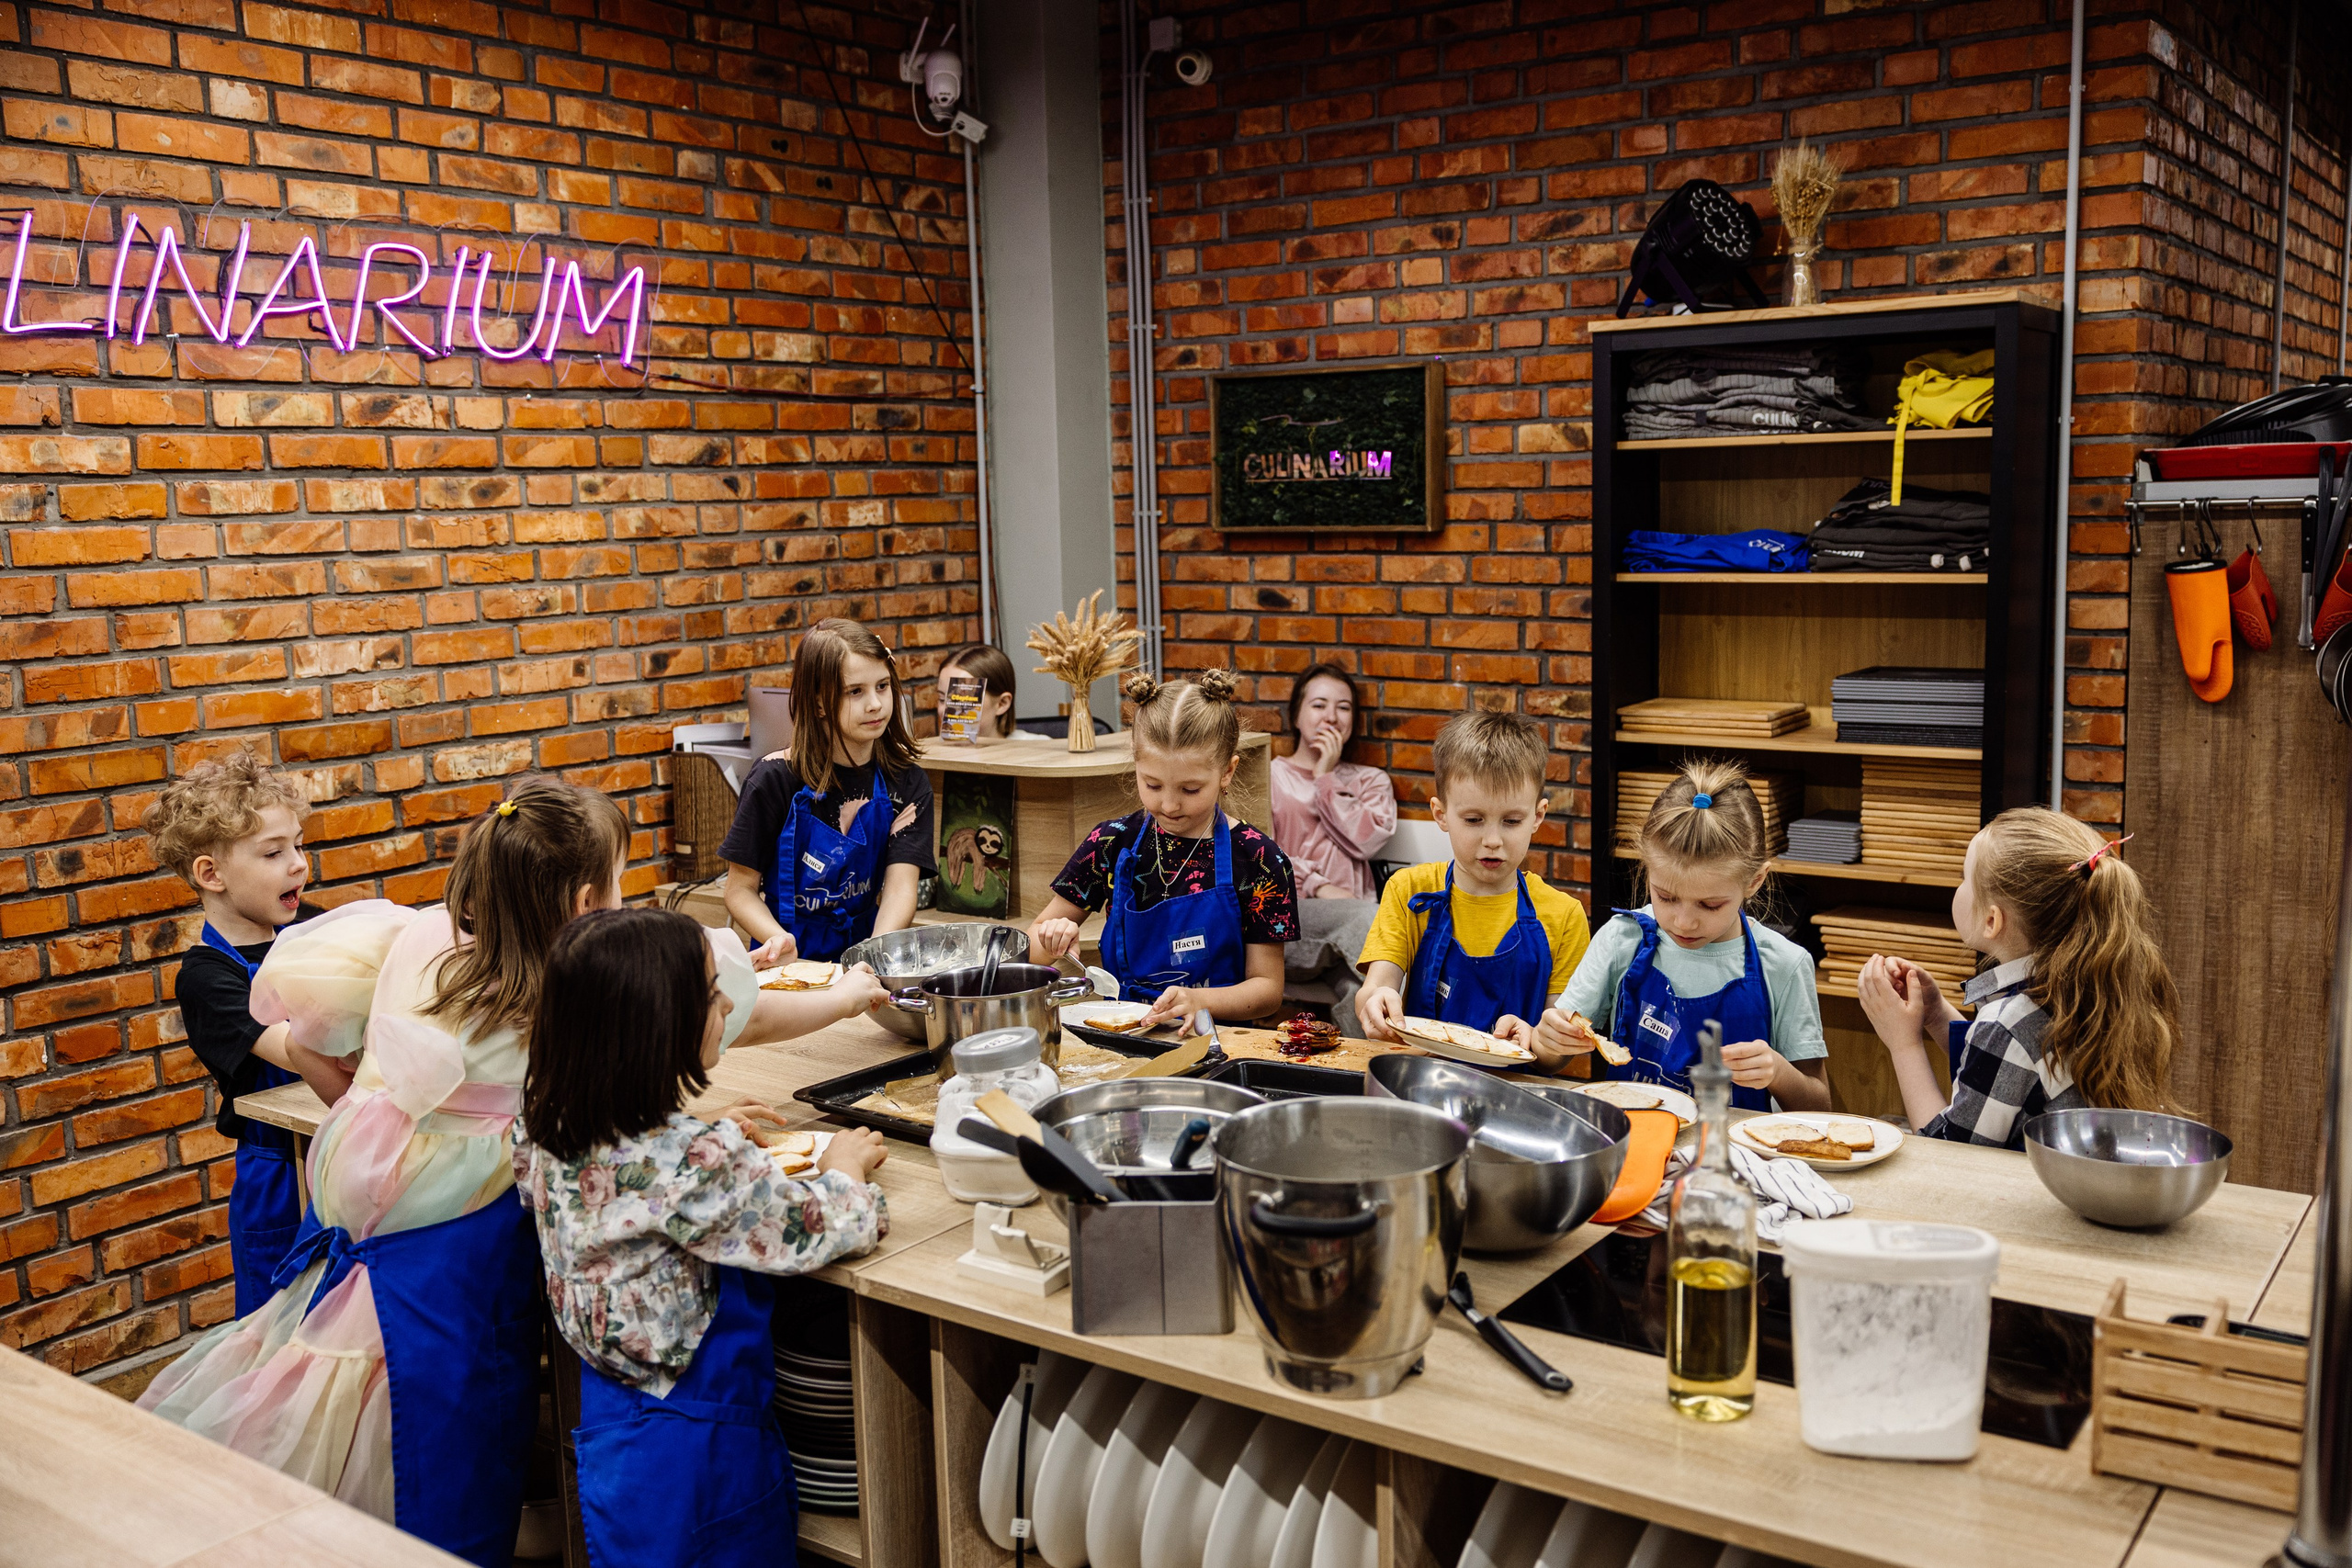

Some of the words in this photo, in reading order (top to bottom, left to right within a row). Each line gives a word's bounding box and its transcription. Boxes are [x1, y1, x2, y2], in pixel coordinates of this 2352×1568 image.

[2, 210, 647, 367] LINARIUM
[1243, 448, 1392, 479] CULINARIUM
[803, 855, 822, 871] Алиса
[1174, 938, 1202, 951] Настя
[1642, 1016, 1670, 1037] Саша
